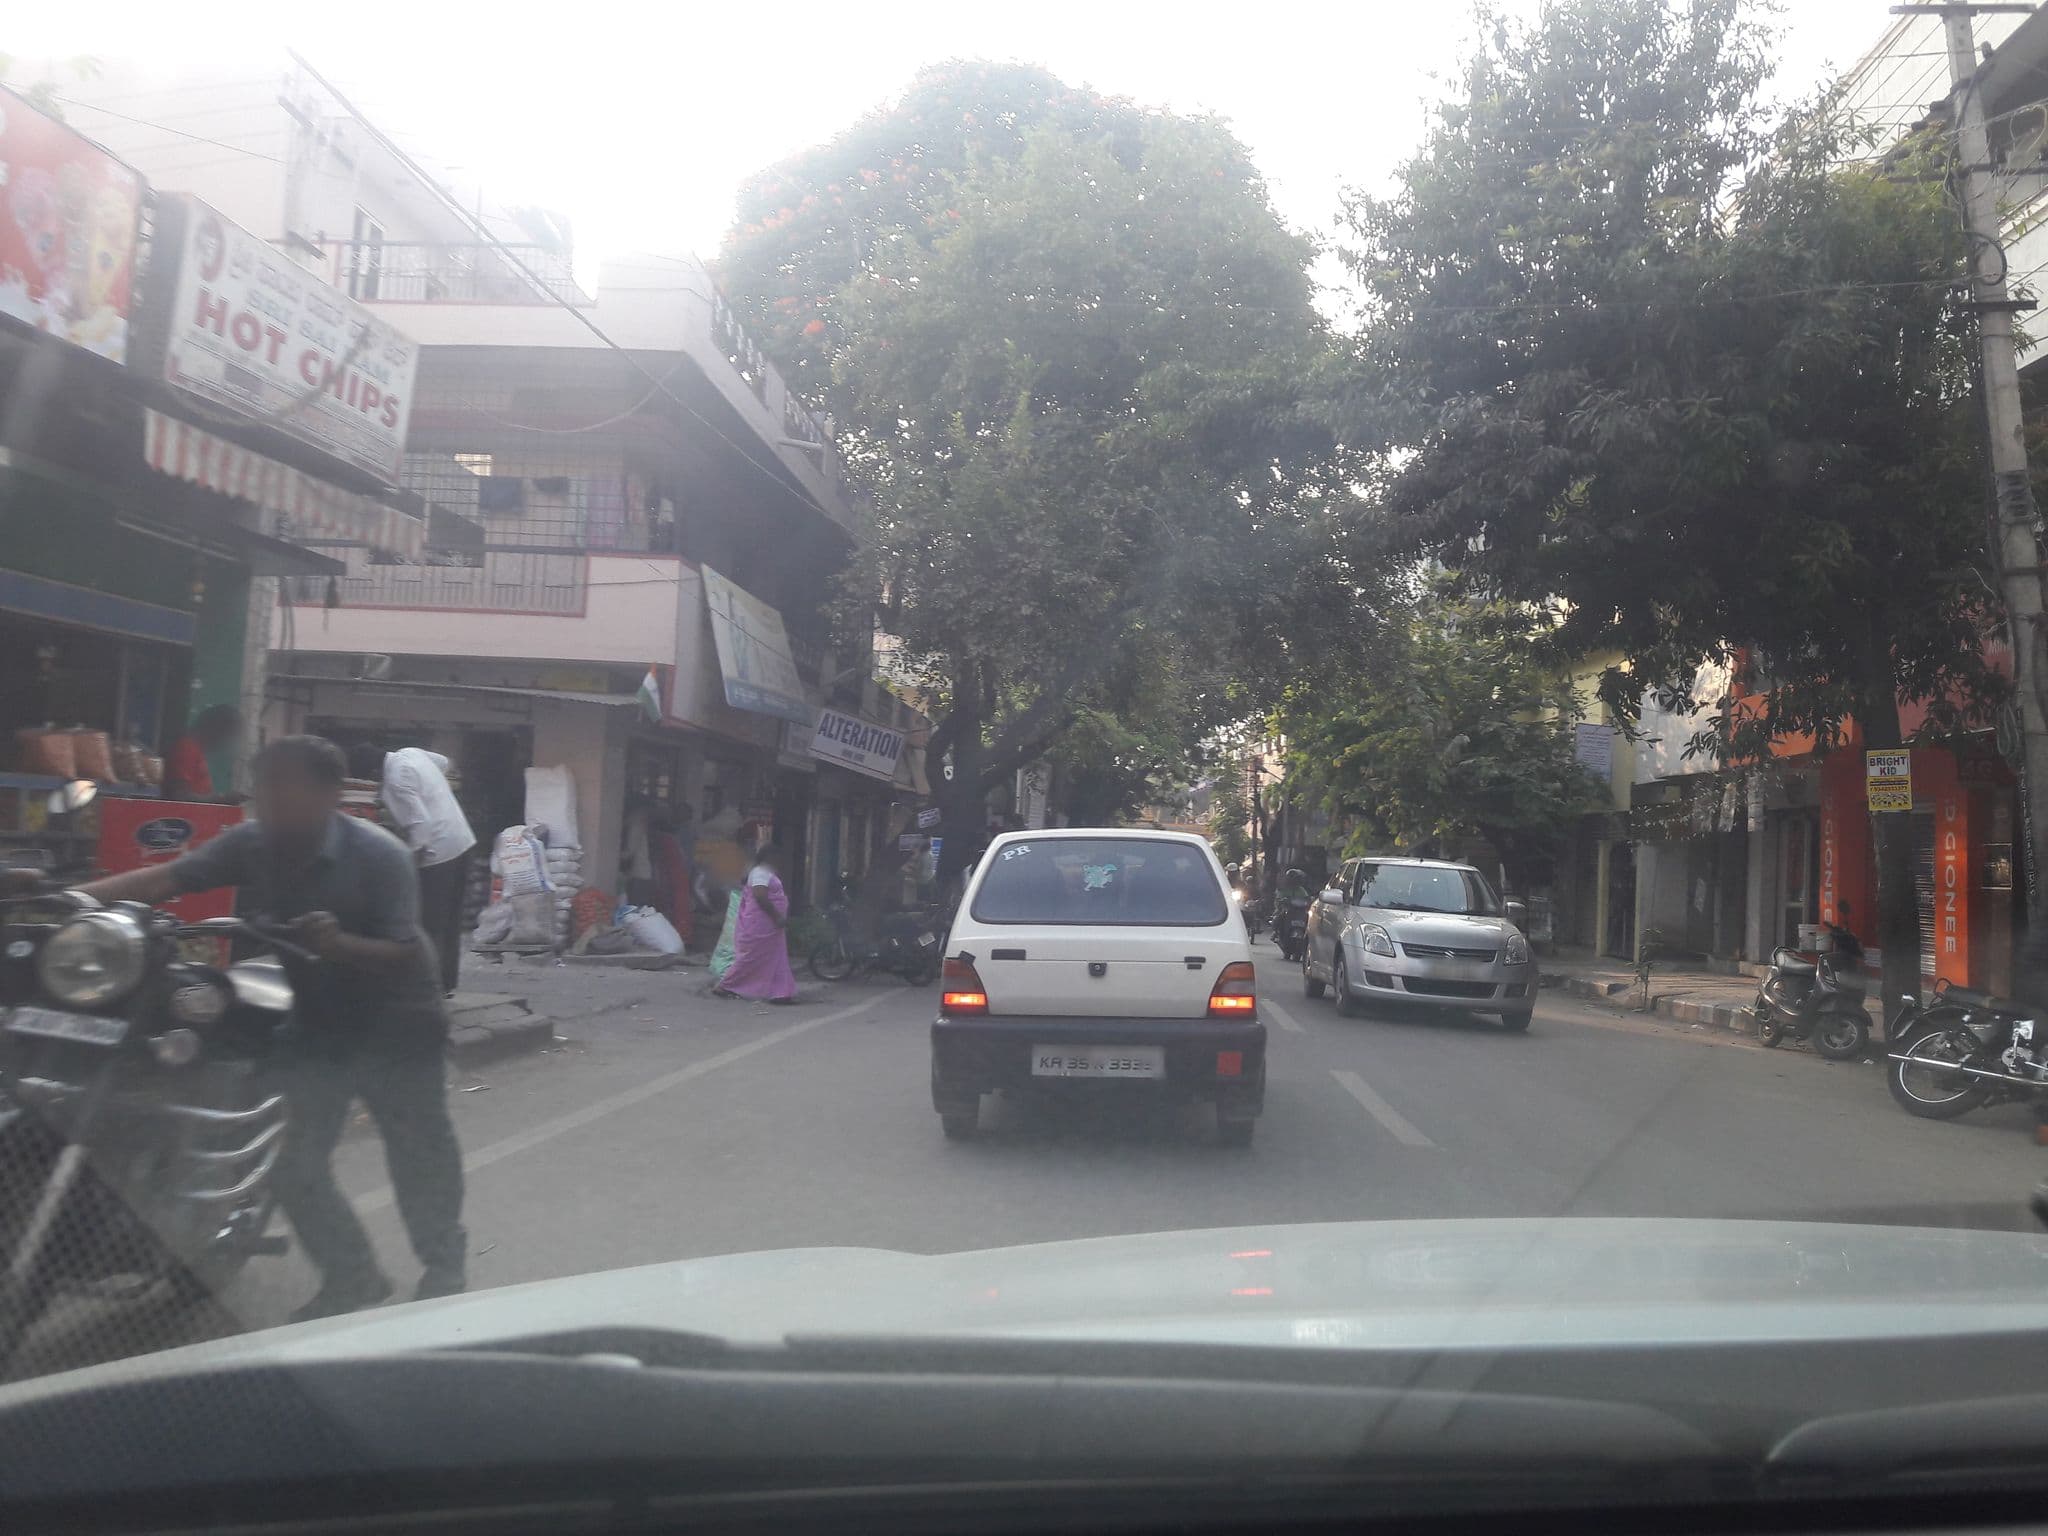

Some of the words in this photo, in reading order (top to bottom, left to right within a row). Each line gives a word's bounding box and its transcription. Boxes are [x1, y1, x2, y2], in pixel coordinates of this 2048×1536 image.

[194, 286, 287, 367] HOT
[298, 349, 400, 428] CHIPS
[817, 712, 902, 760] ALTERATION
[1869, 756, 1906, 767] BRIGHT
[1879, 766, 1897, 776] KID
[1001, 845, 1032, 861] PR
[1823, 819, 1834, 922] GIONEE
[1944, 832, 1957, 953] GIONEE
[1040, 1056, 1062, 1069] KA
[1066, 1057, 1090, 1070] 35
